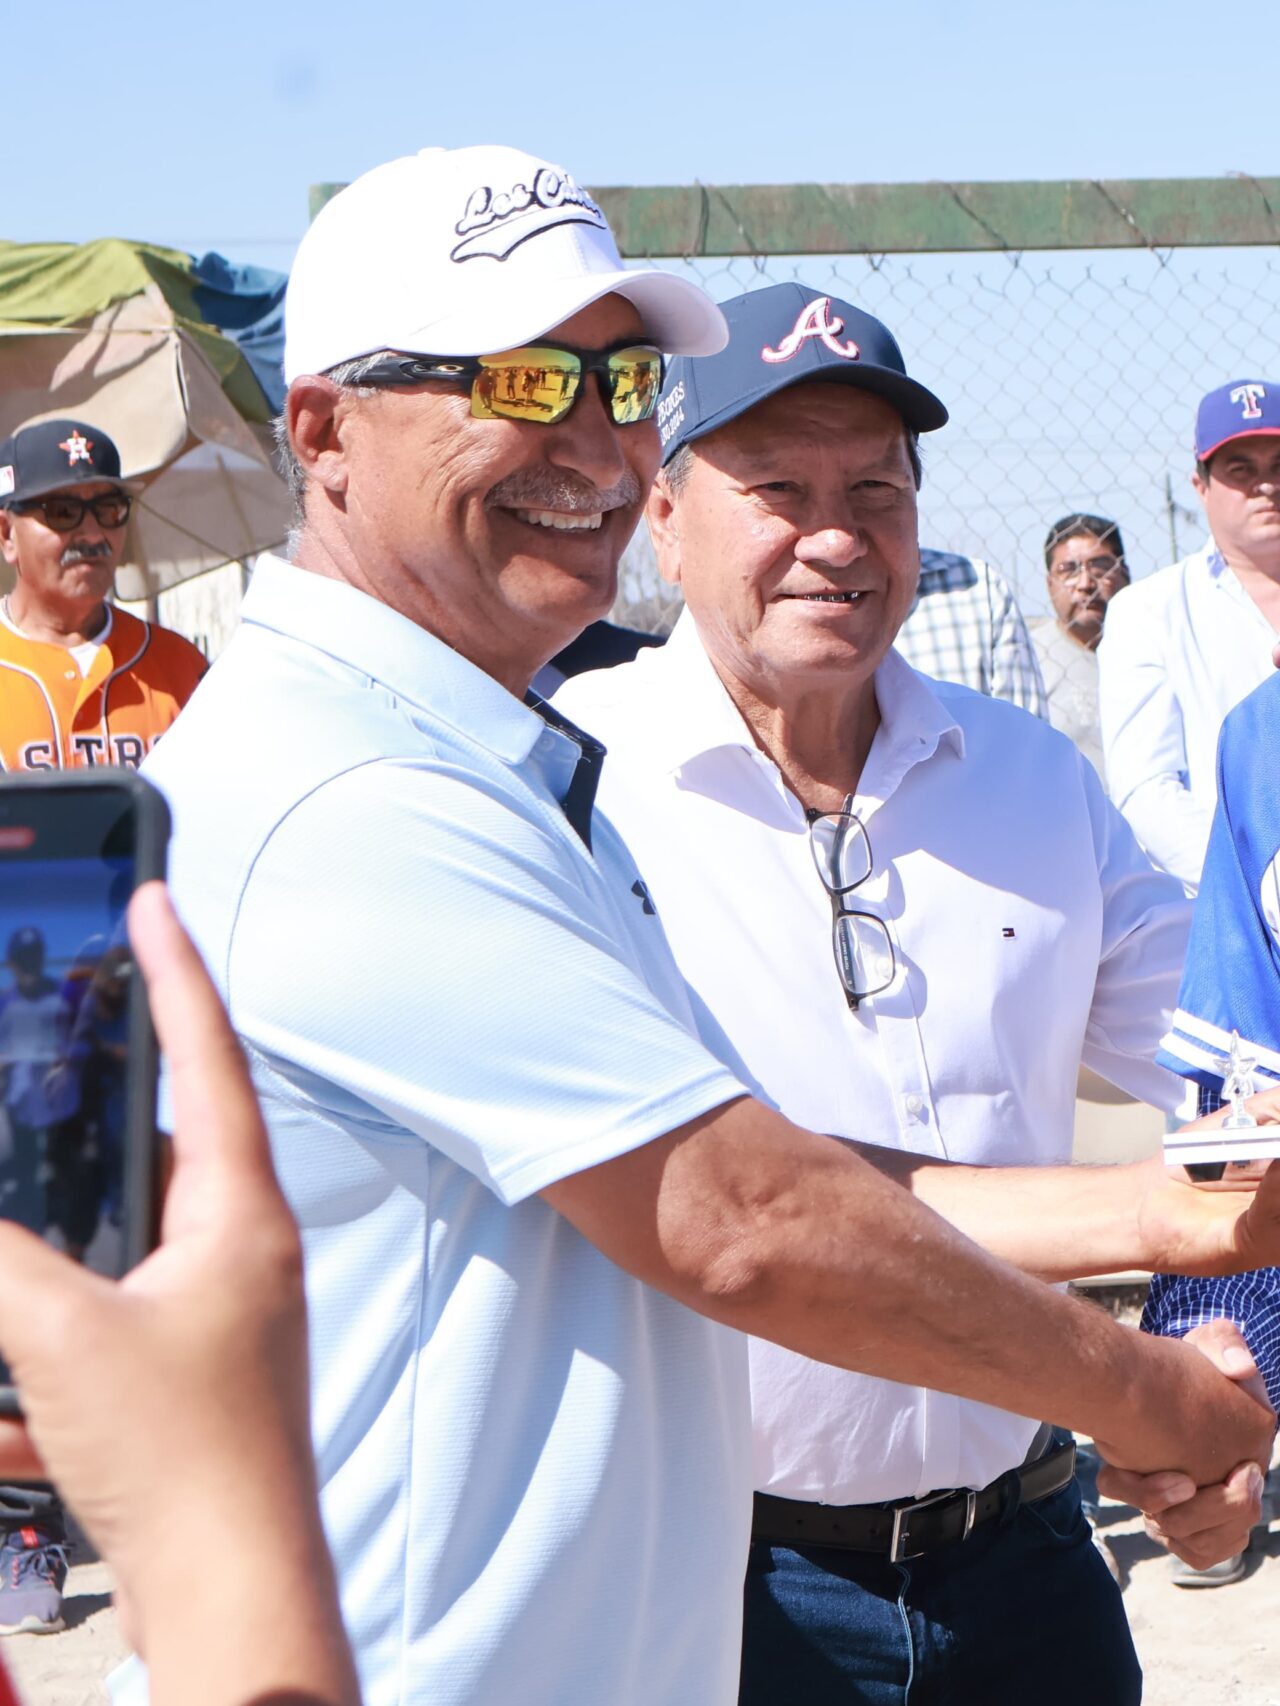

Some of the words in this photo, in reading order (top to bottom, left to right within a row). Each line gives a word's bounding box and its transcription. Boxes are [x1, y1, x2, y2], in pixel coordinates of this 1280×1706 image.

[455, 186, 531, 236] Los
[761, 297, 860, 363] A
[1229, 384, 1265, 419] T
[66, 437, 90, 460] H
[18, 733, 162, 772] STR
